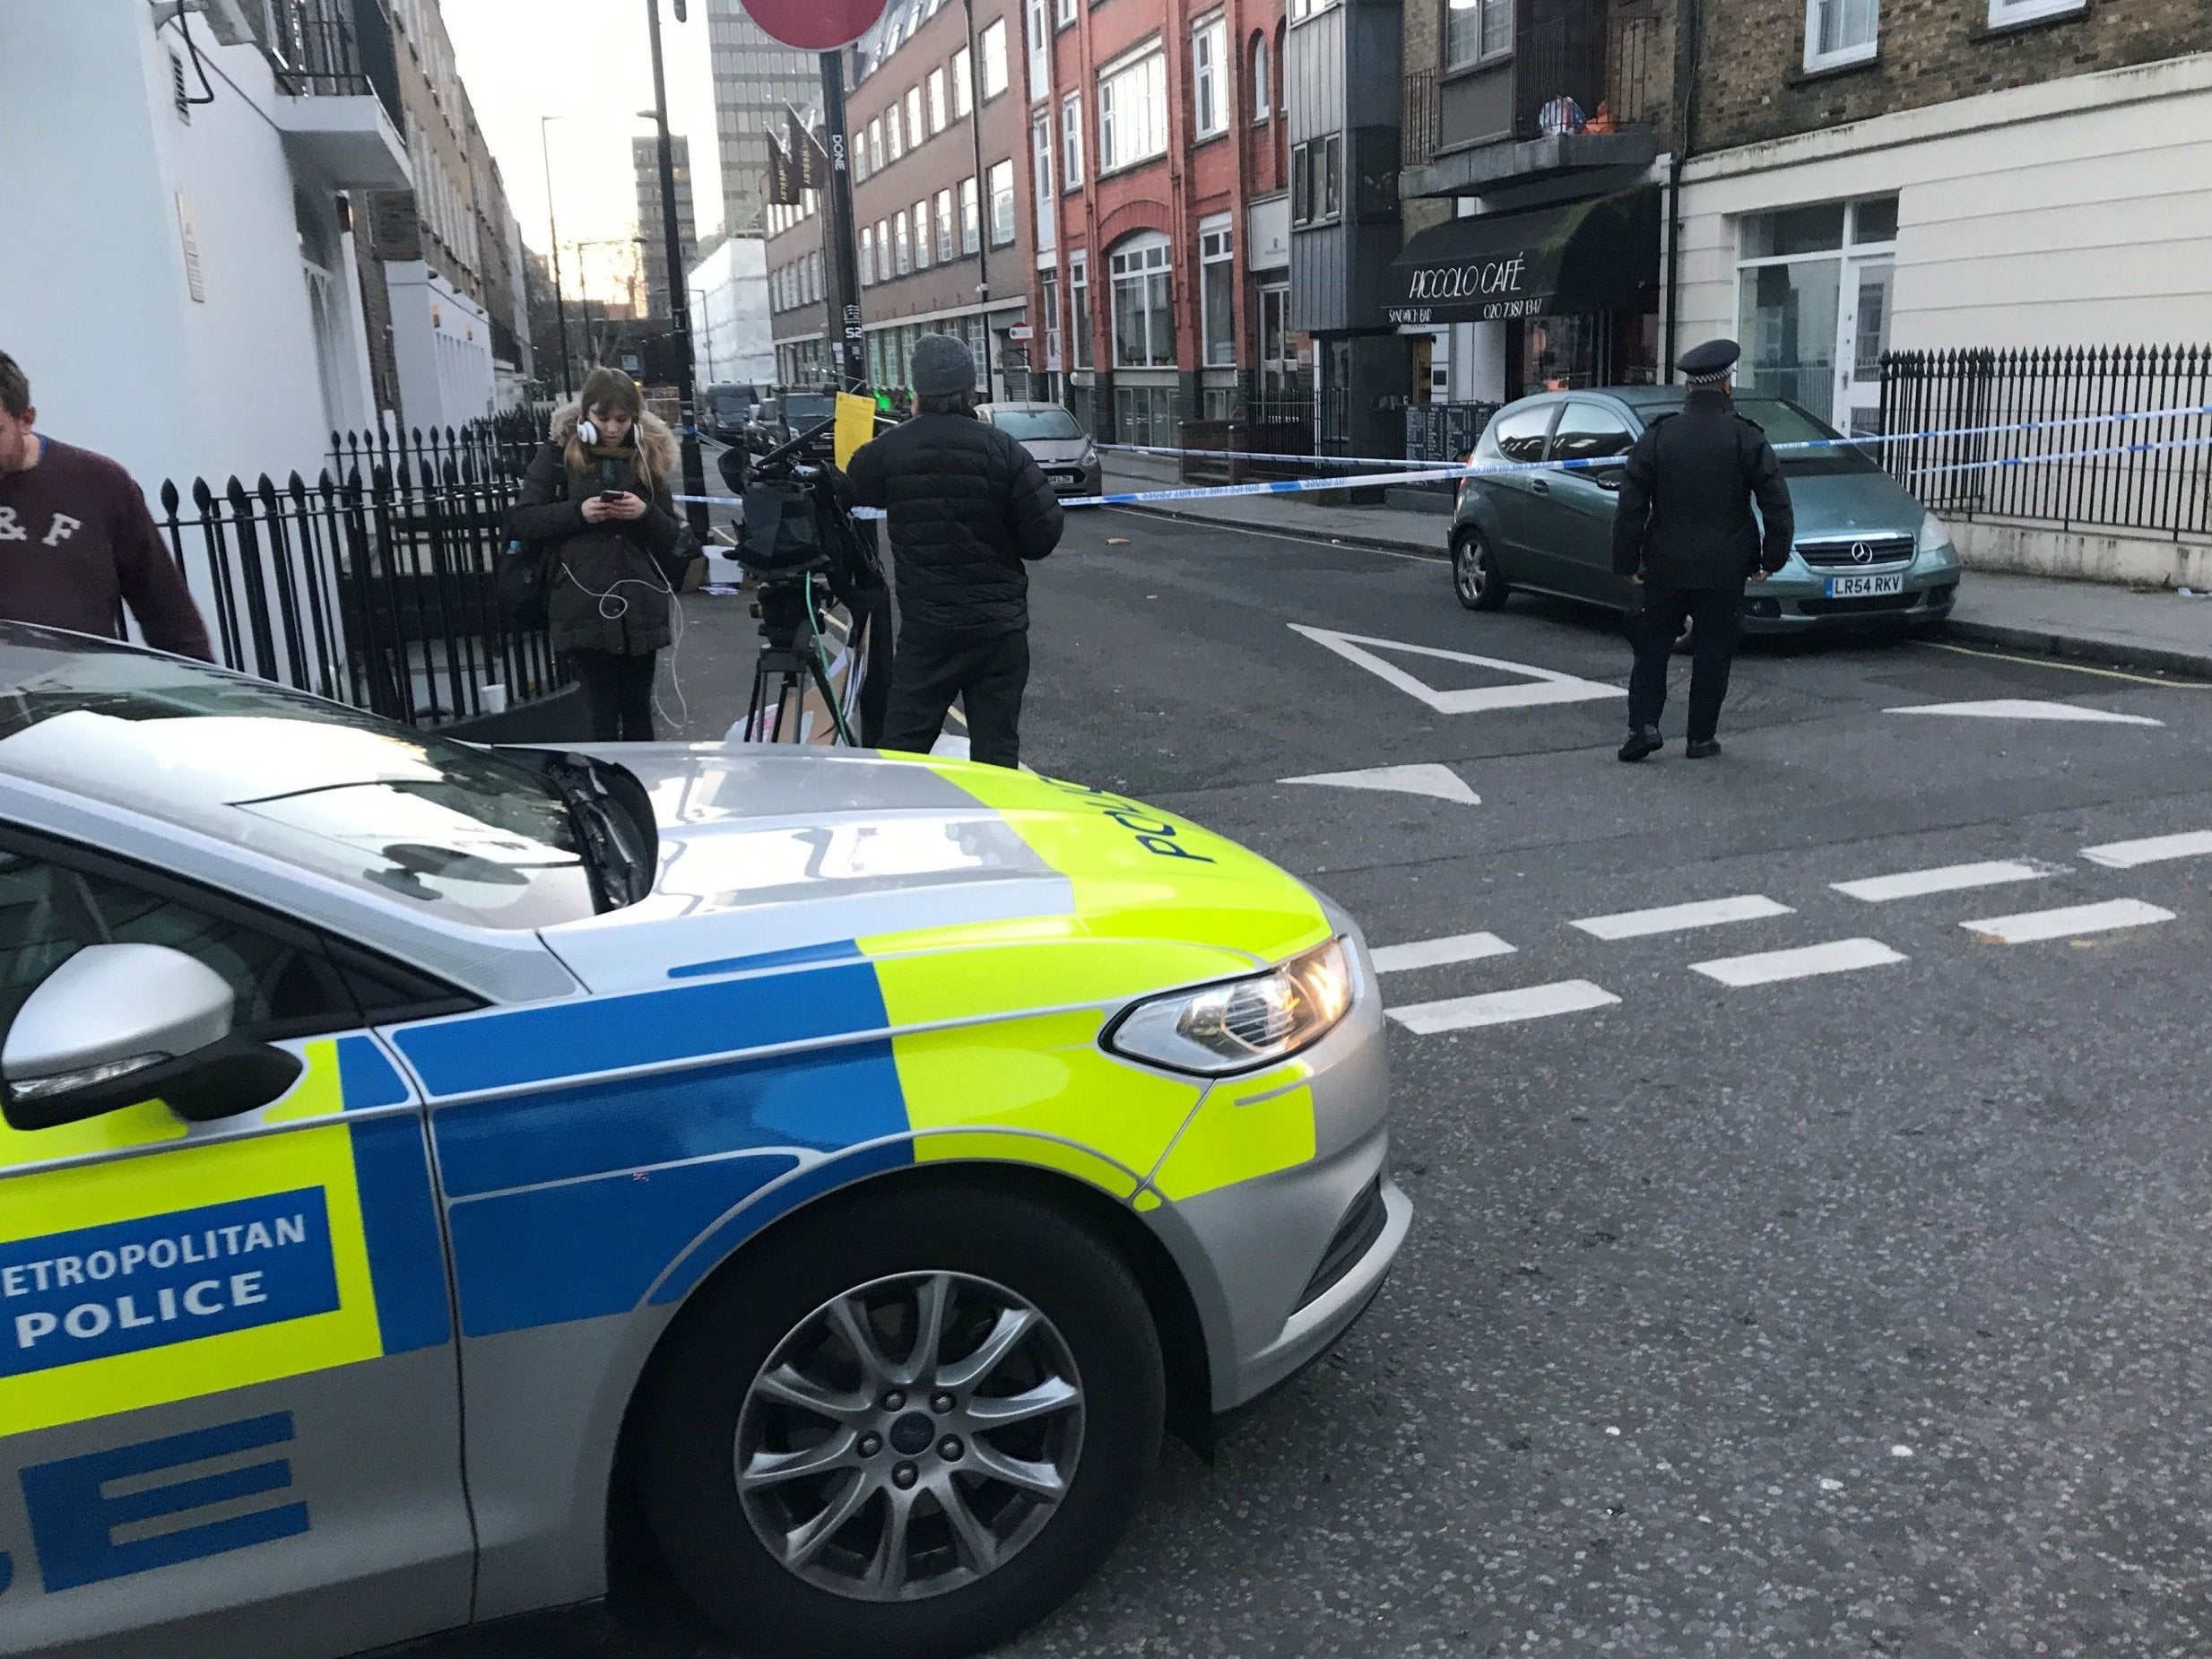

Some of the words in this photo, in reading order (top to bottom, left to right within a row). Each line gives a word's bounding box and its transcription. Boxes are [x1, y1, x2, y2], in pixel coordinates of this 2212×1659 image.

[832, 135, 846, 171] DONE
[1409, 266, 1479, 300] PICCOLO
[1480, 251, 1526, 294] CAFÉ
[1419, 308, 1433, 323] BAR
[1483, 302, 1503, 319] 020
[1503, 300, 1524, 318] 7387
[0, 506, 27, 541] &
[42, 512, 82, 546] F
[1835, 577, 1871, 595] LR54
[1875, 575, 1900, 592] RKV
[0, 1213, 306, 1298] ETROPOLITAN
[15, 1270, 268, 1349] POLICE
